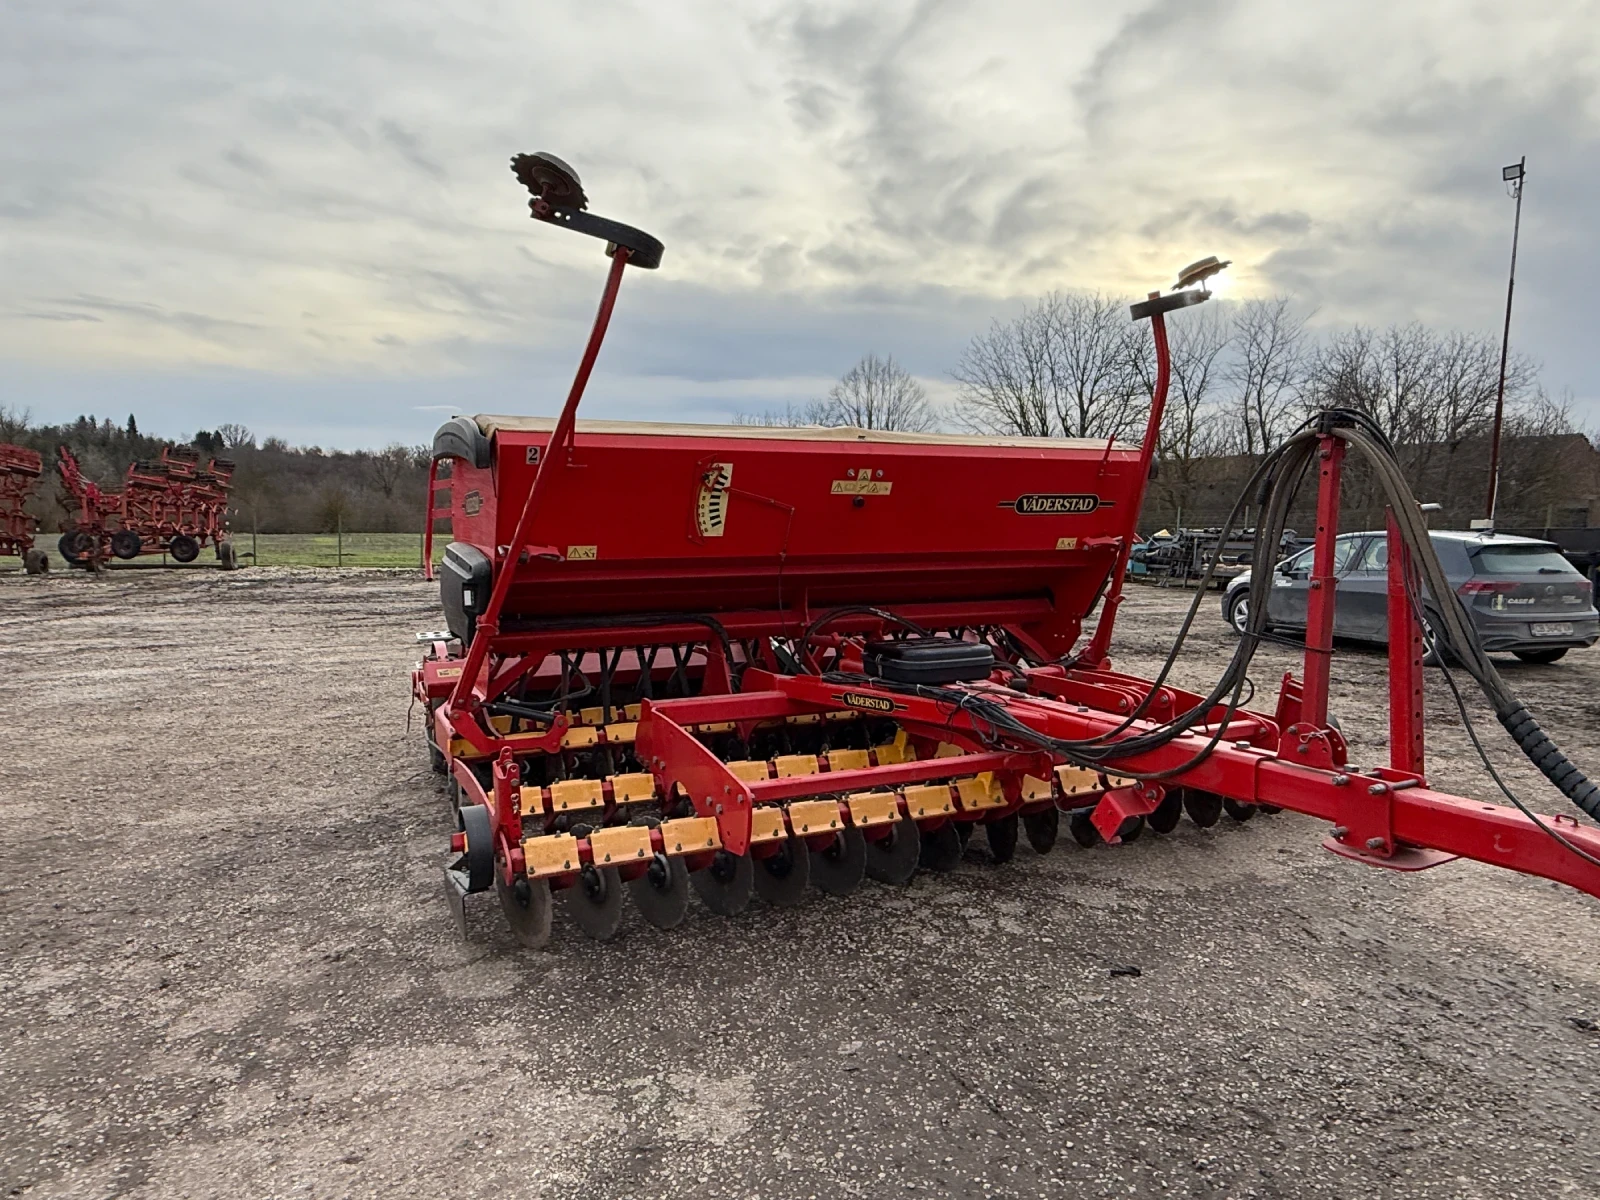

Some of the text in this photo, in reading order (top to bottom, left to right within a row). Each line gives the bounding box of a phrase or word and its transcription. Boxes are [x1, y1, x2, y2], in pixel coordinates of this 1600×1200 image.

[528, 447, 538, 461] 2
[1022, 496, 1094, 511] VÄDERSTAD
[847, 694, 890, 710] VÄDERSTAD
